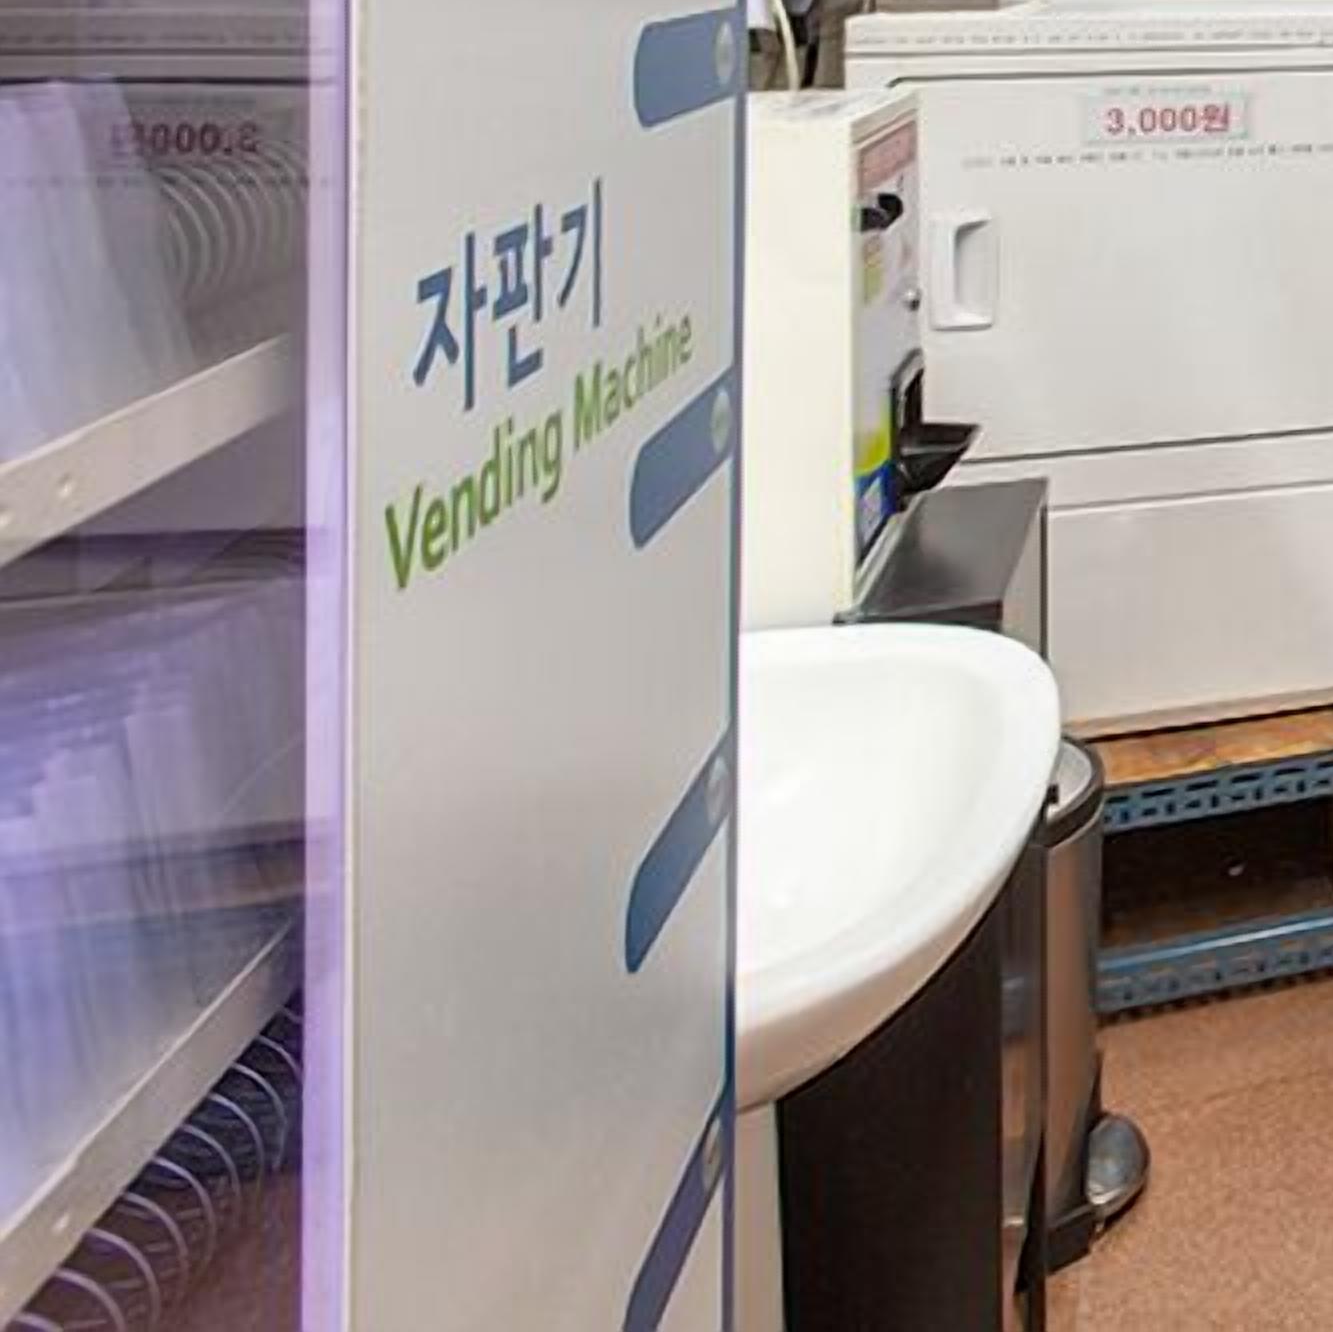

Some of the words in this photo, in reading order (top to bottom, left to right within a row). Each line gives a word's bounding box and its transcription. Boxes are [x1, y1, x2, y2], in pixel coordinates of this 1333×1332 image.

[1105, 104, 1231, 135] 3,000원
[412, 175, 603, 413] 자판기
[385, 408, 562, 592] Vending
[573, 312, 692, 451] Machine
